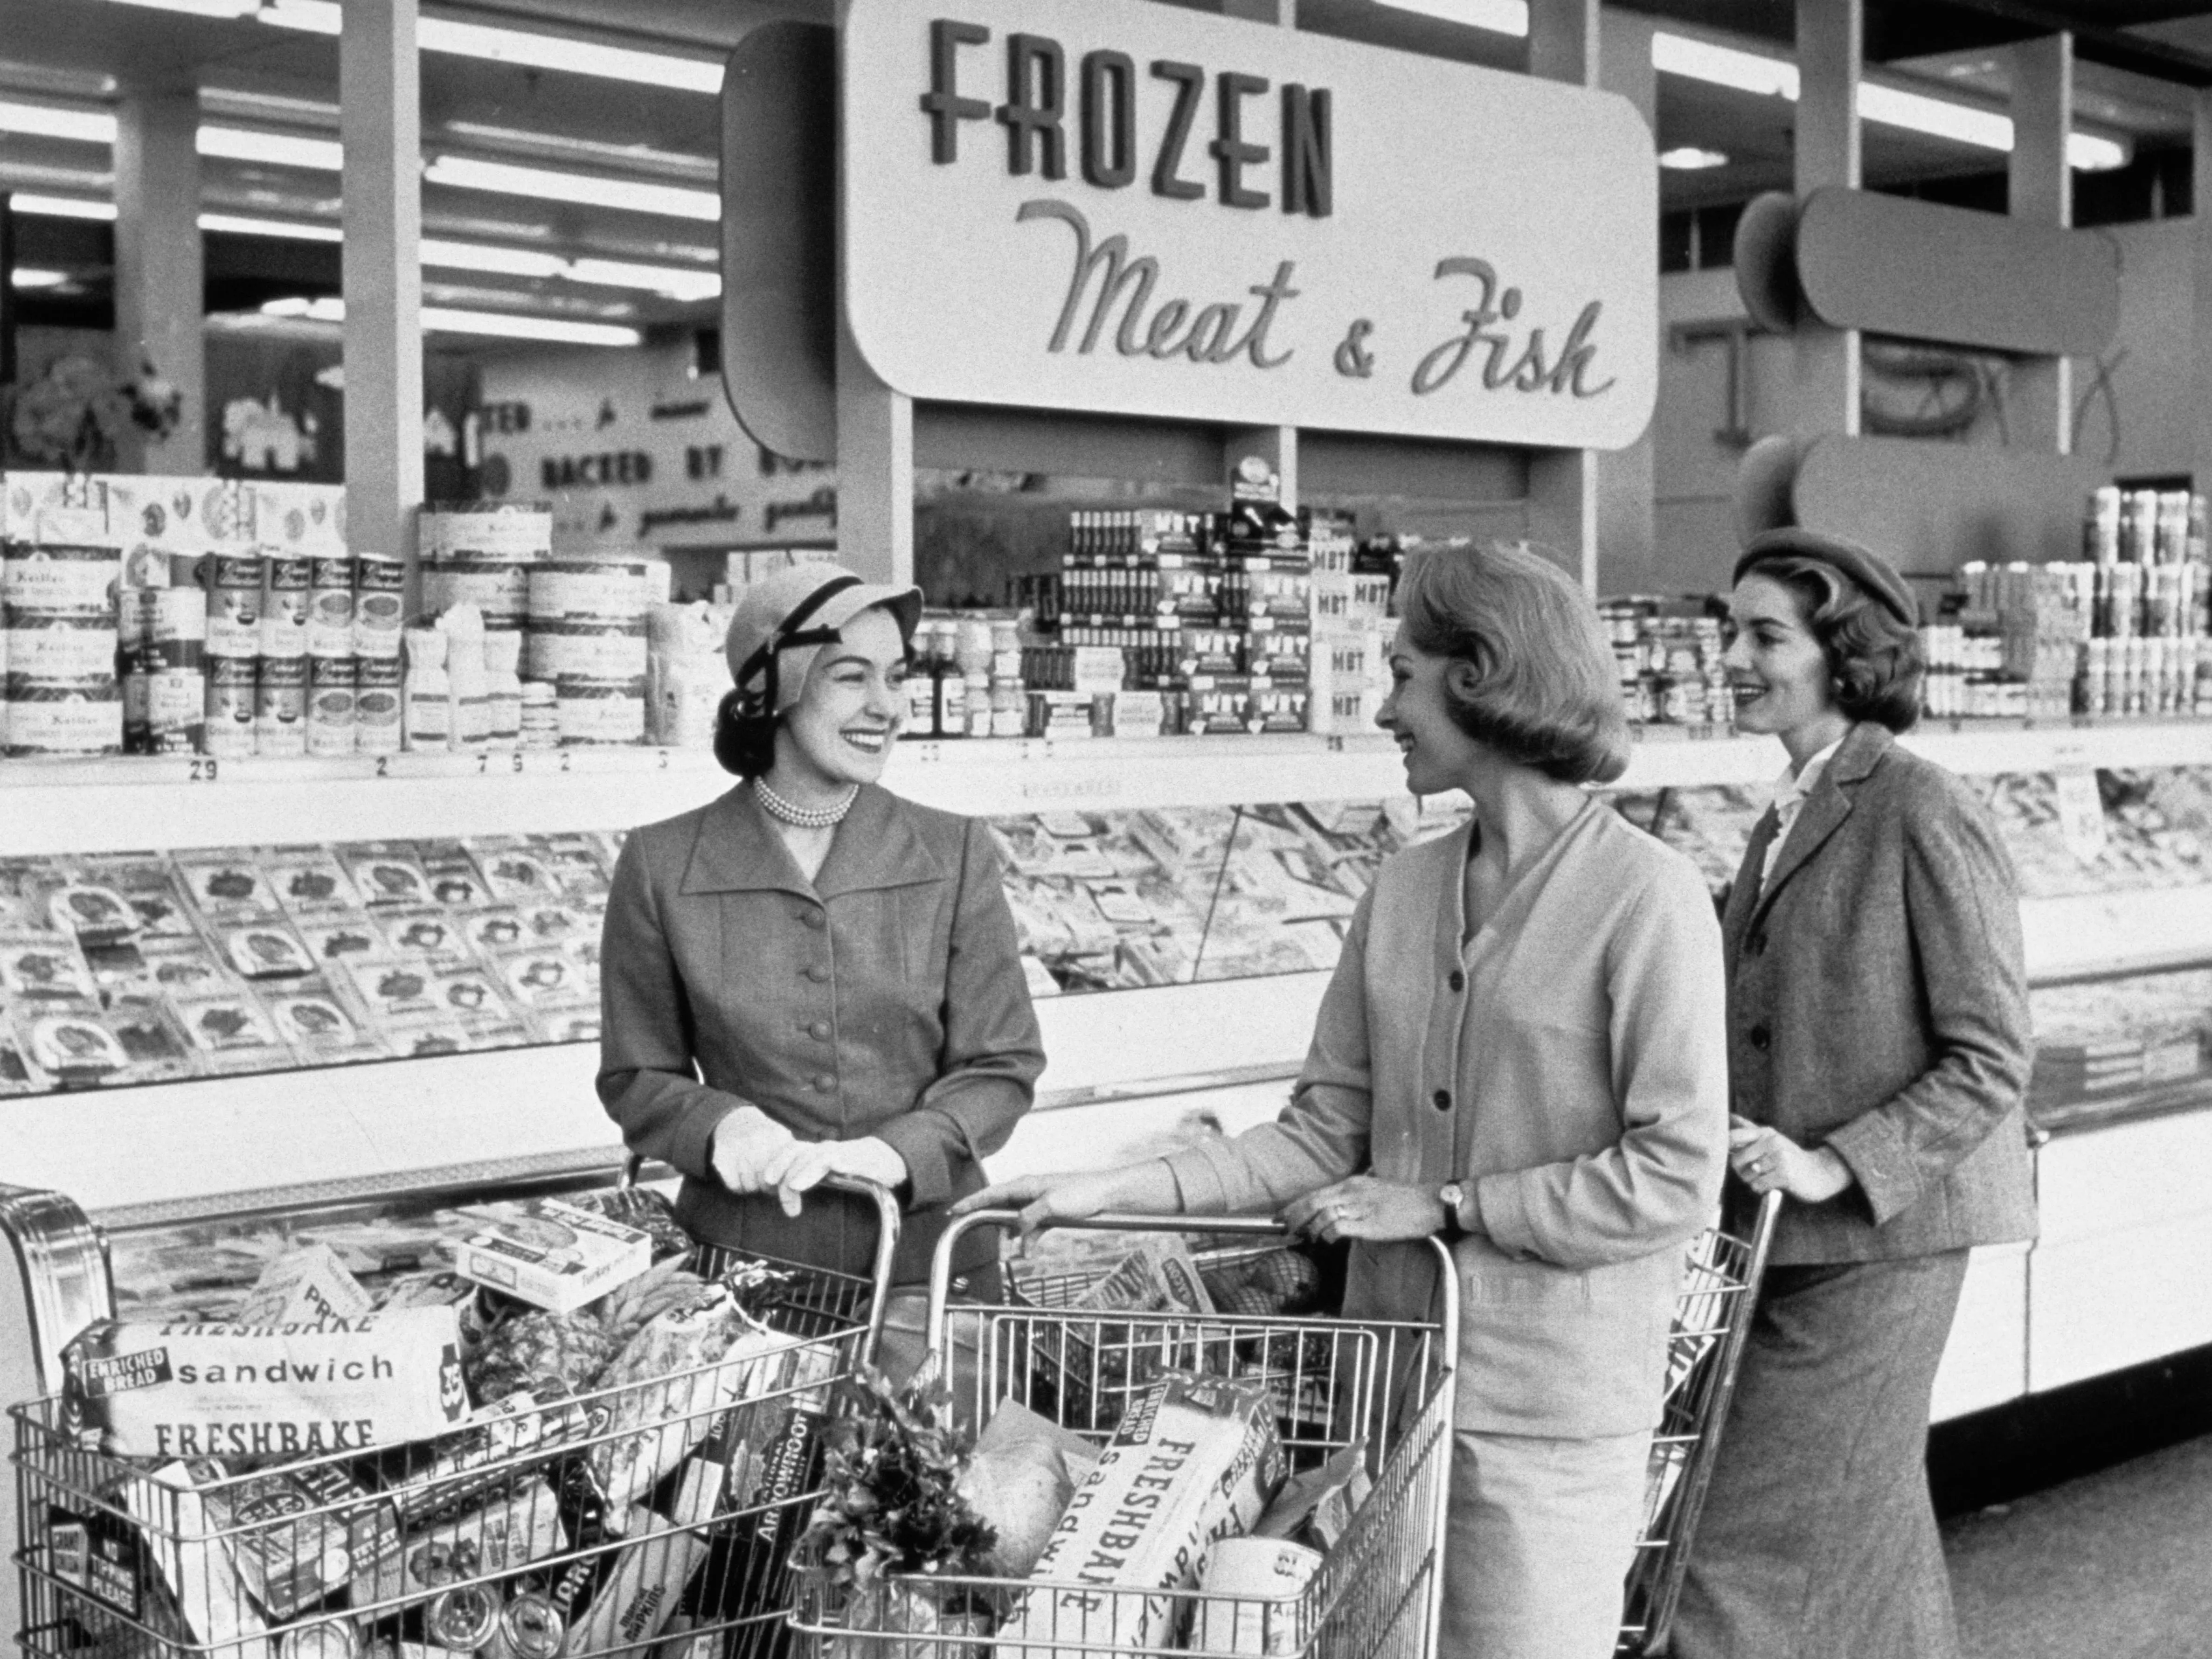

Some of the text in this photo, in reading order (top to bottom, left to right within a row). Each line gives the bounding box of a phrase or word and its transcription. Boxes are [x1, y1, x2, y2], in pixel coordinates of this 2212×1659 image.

[920, 18, 1333, 219] FROZEN
[1014, 199, 1617, 400] Meat & Fish
[189, 759, 218, 780] 29
[376, 756, 387, 776] 2
[89, 1350, 164, 1379] ENRICHED
[179, 1354, 393, 1384] sandwich
[104, 1368, 156, 1392] BREAD
[155, 1419, 374, 1456] FRESHBAKE
